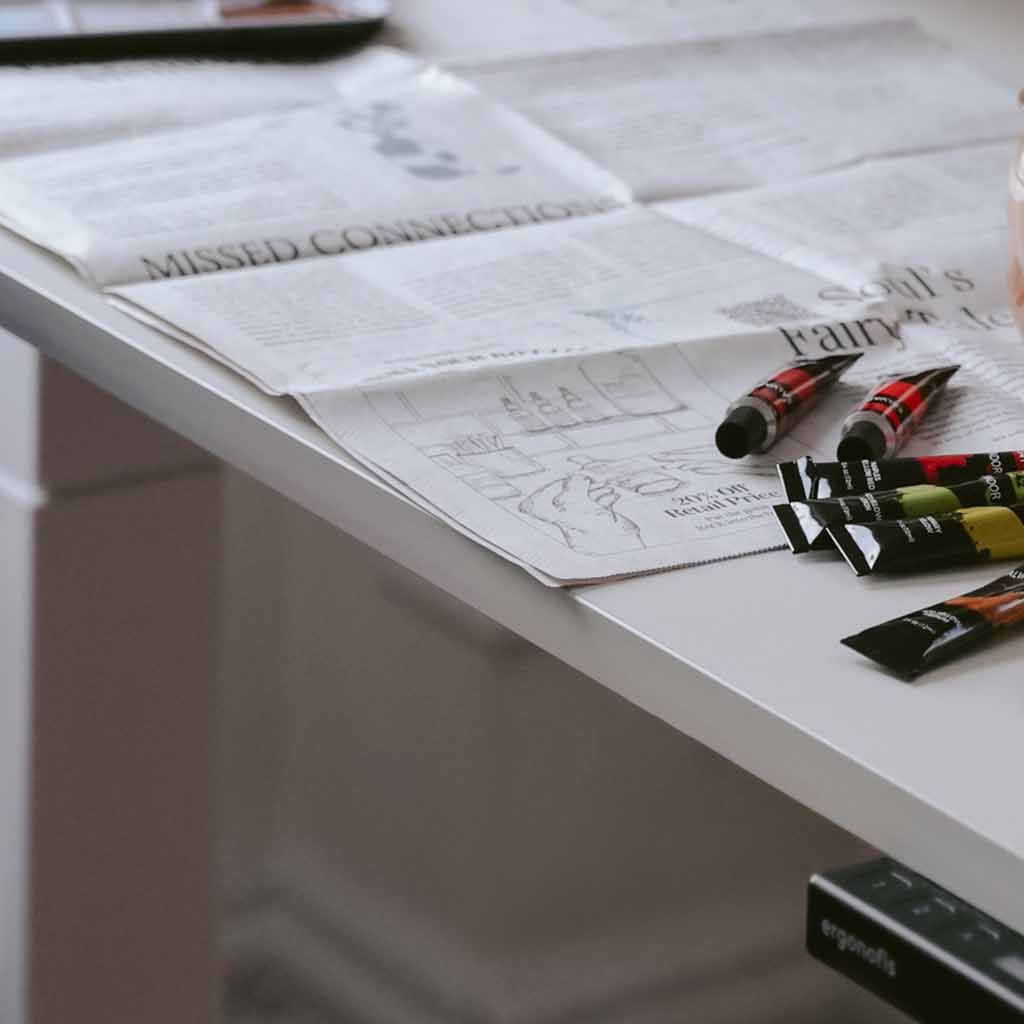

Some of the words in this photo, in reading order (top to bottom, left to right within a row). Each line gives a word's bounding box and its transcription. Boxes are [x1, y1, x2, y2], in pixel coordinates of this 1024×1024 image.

[141, 236, 300, 280] MISSED
[779, 314, 905, 357] Fairy
[664, 499, 728, 519] Retail
[725, 490, 780, 506] Price
